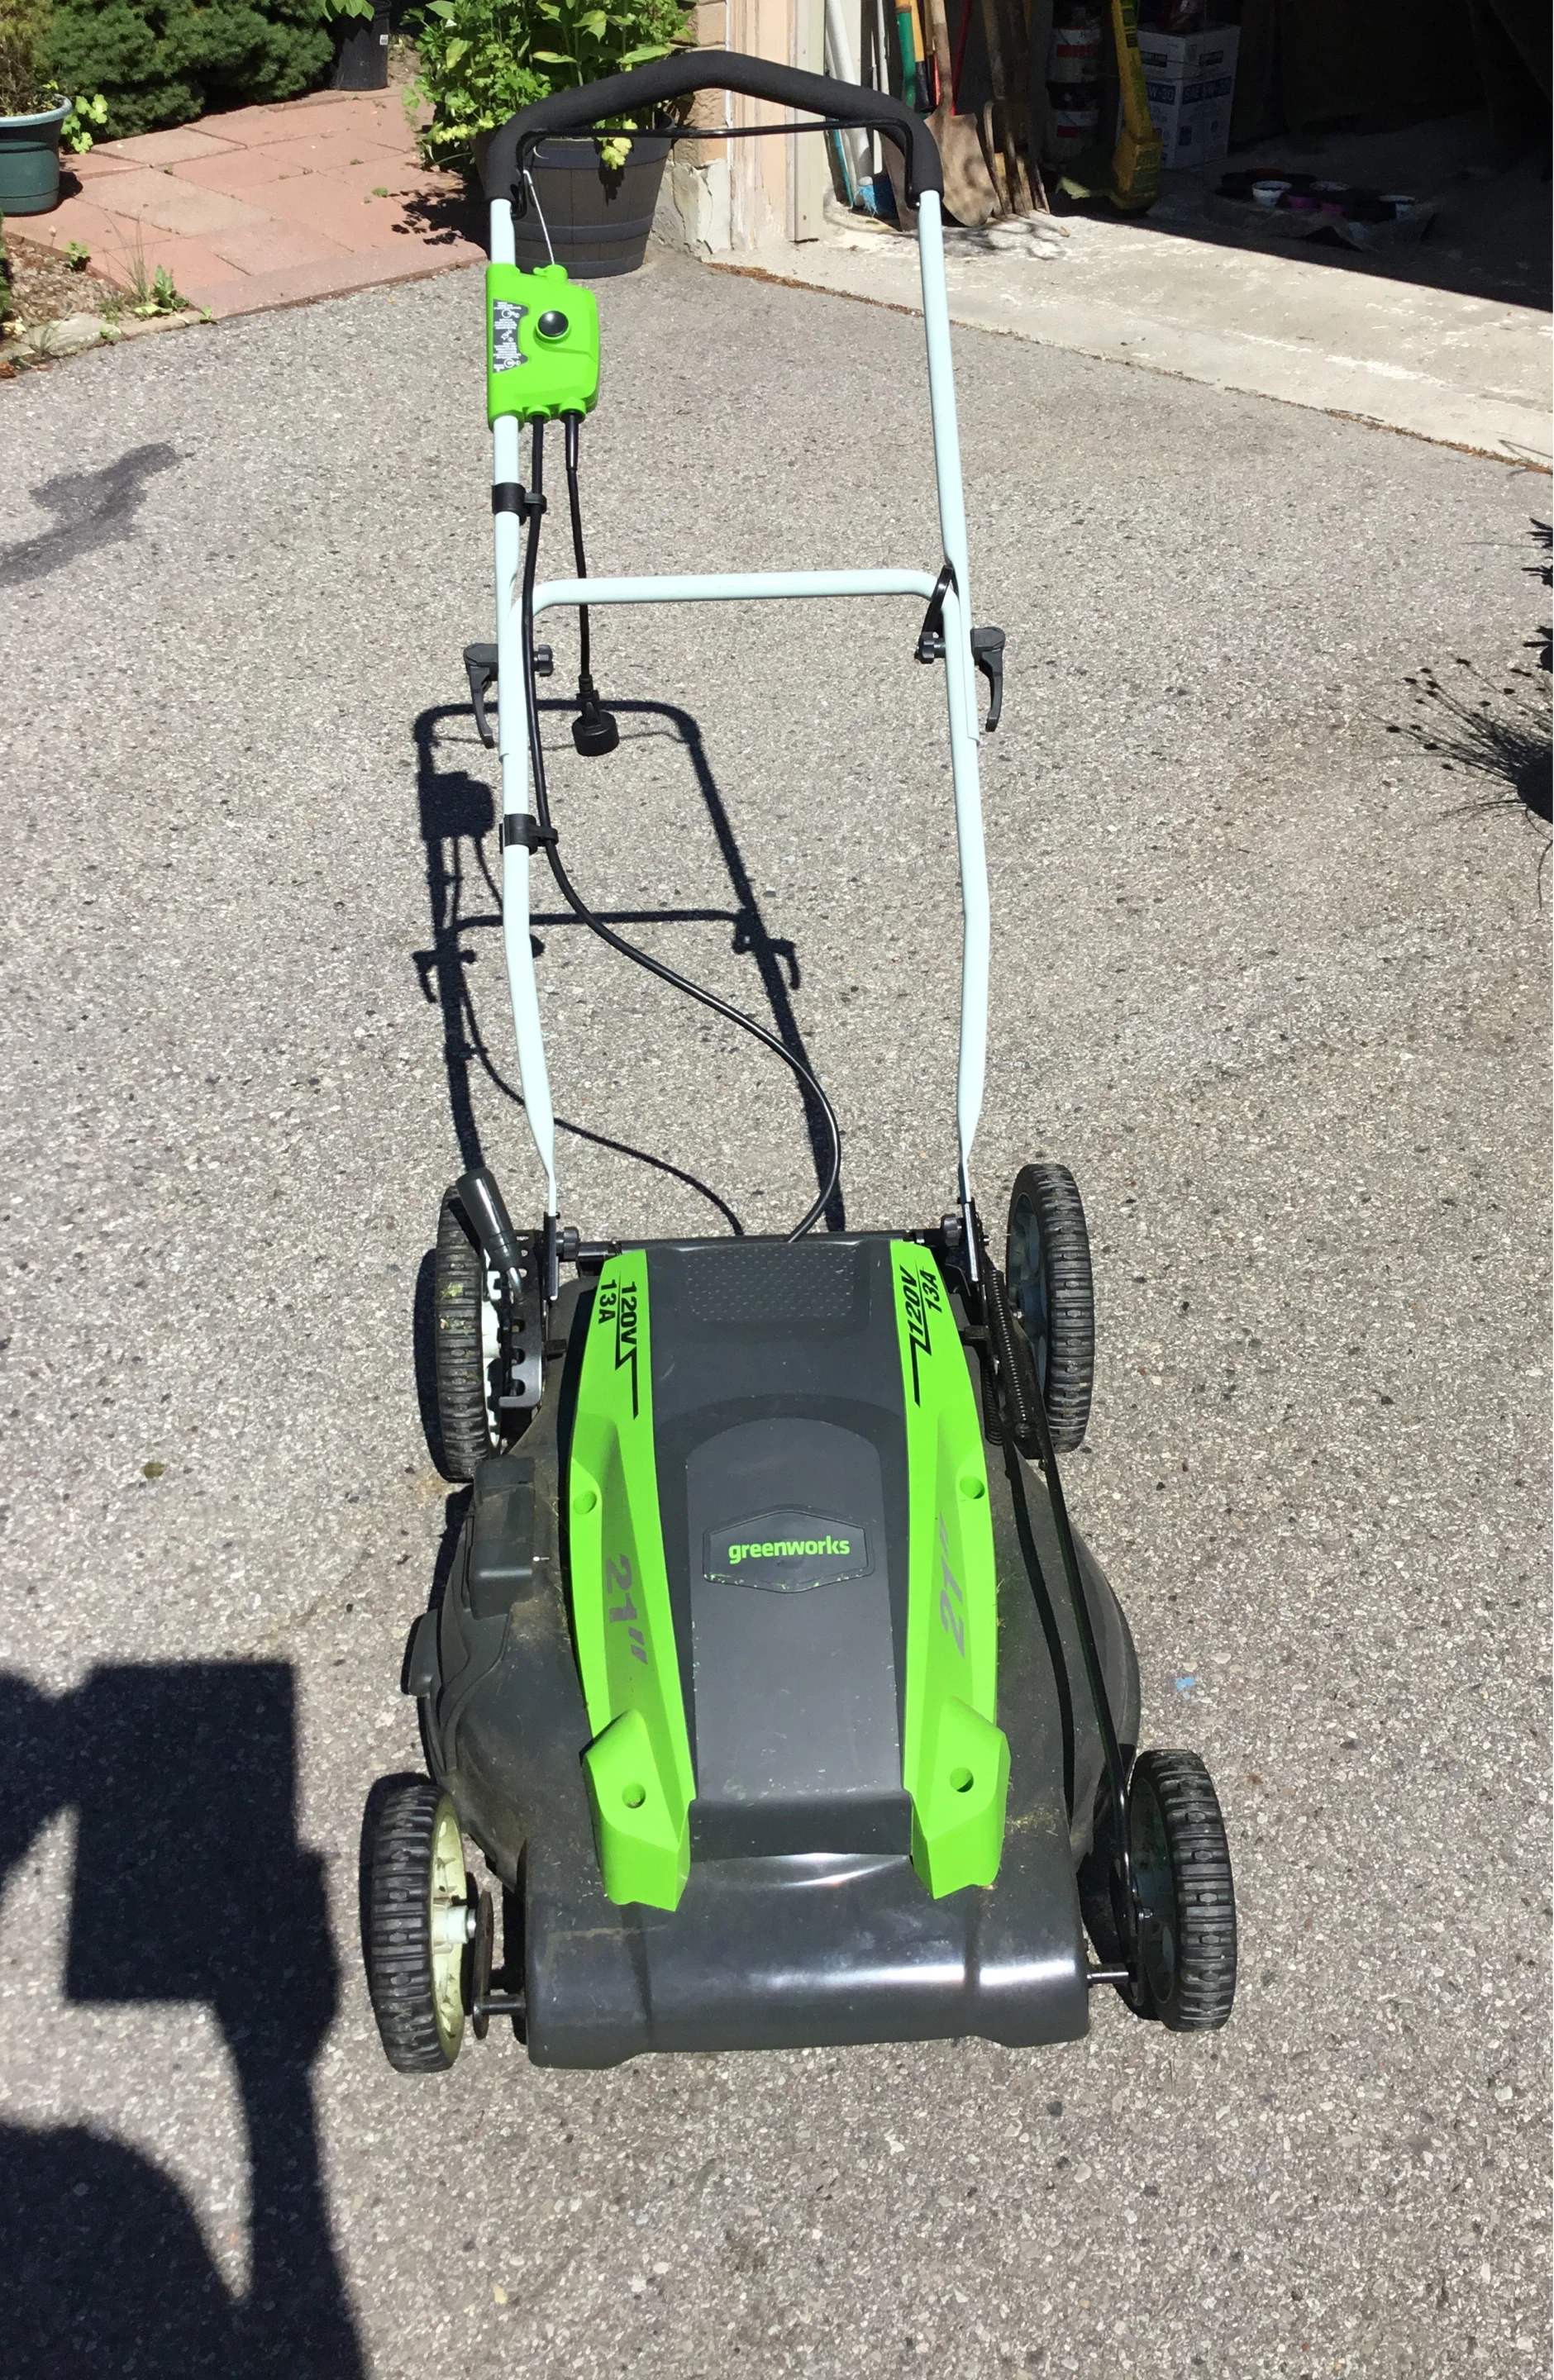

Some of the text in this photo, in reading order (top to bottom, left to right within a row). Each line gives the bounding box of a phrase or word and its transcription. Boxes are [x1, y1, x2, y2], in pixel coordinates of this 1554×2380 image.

[1147, 86, 1174, 101] W-30
[598, 1278, 617, 1325] 13A
[620, 1281, 637, 1345] 120V
[899, 1264, 925, 1337] 120V
[919, 1269, 942, 1313] 13A
[728, 1535, 851, 1564] greenworks
